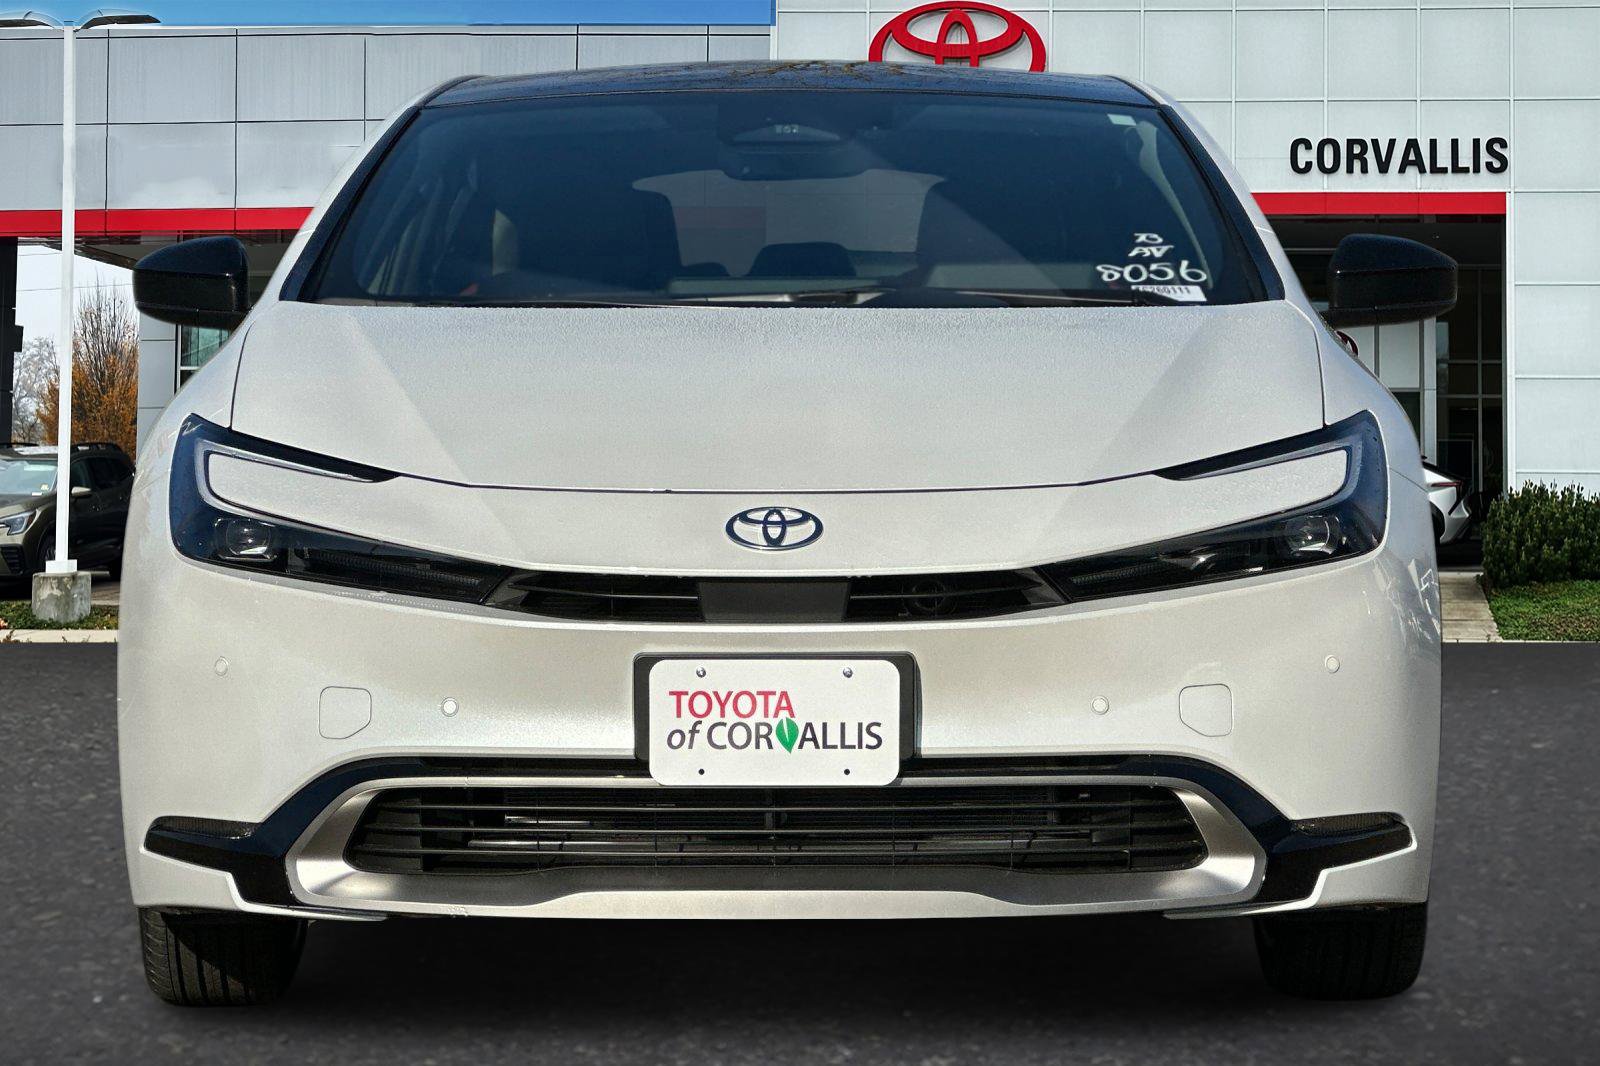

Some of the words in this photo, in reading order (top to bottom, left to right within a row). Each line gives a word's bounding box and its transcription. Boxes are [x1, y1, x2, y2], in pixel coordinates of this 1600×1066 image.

[1290, 137, 1509, 174] CORVALLIS
[1095, 260, 1208, 282] 8056
[668, 690, 796, 719] TOYOTA
[666, 720, 703, 750] of
